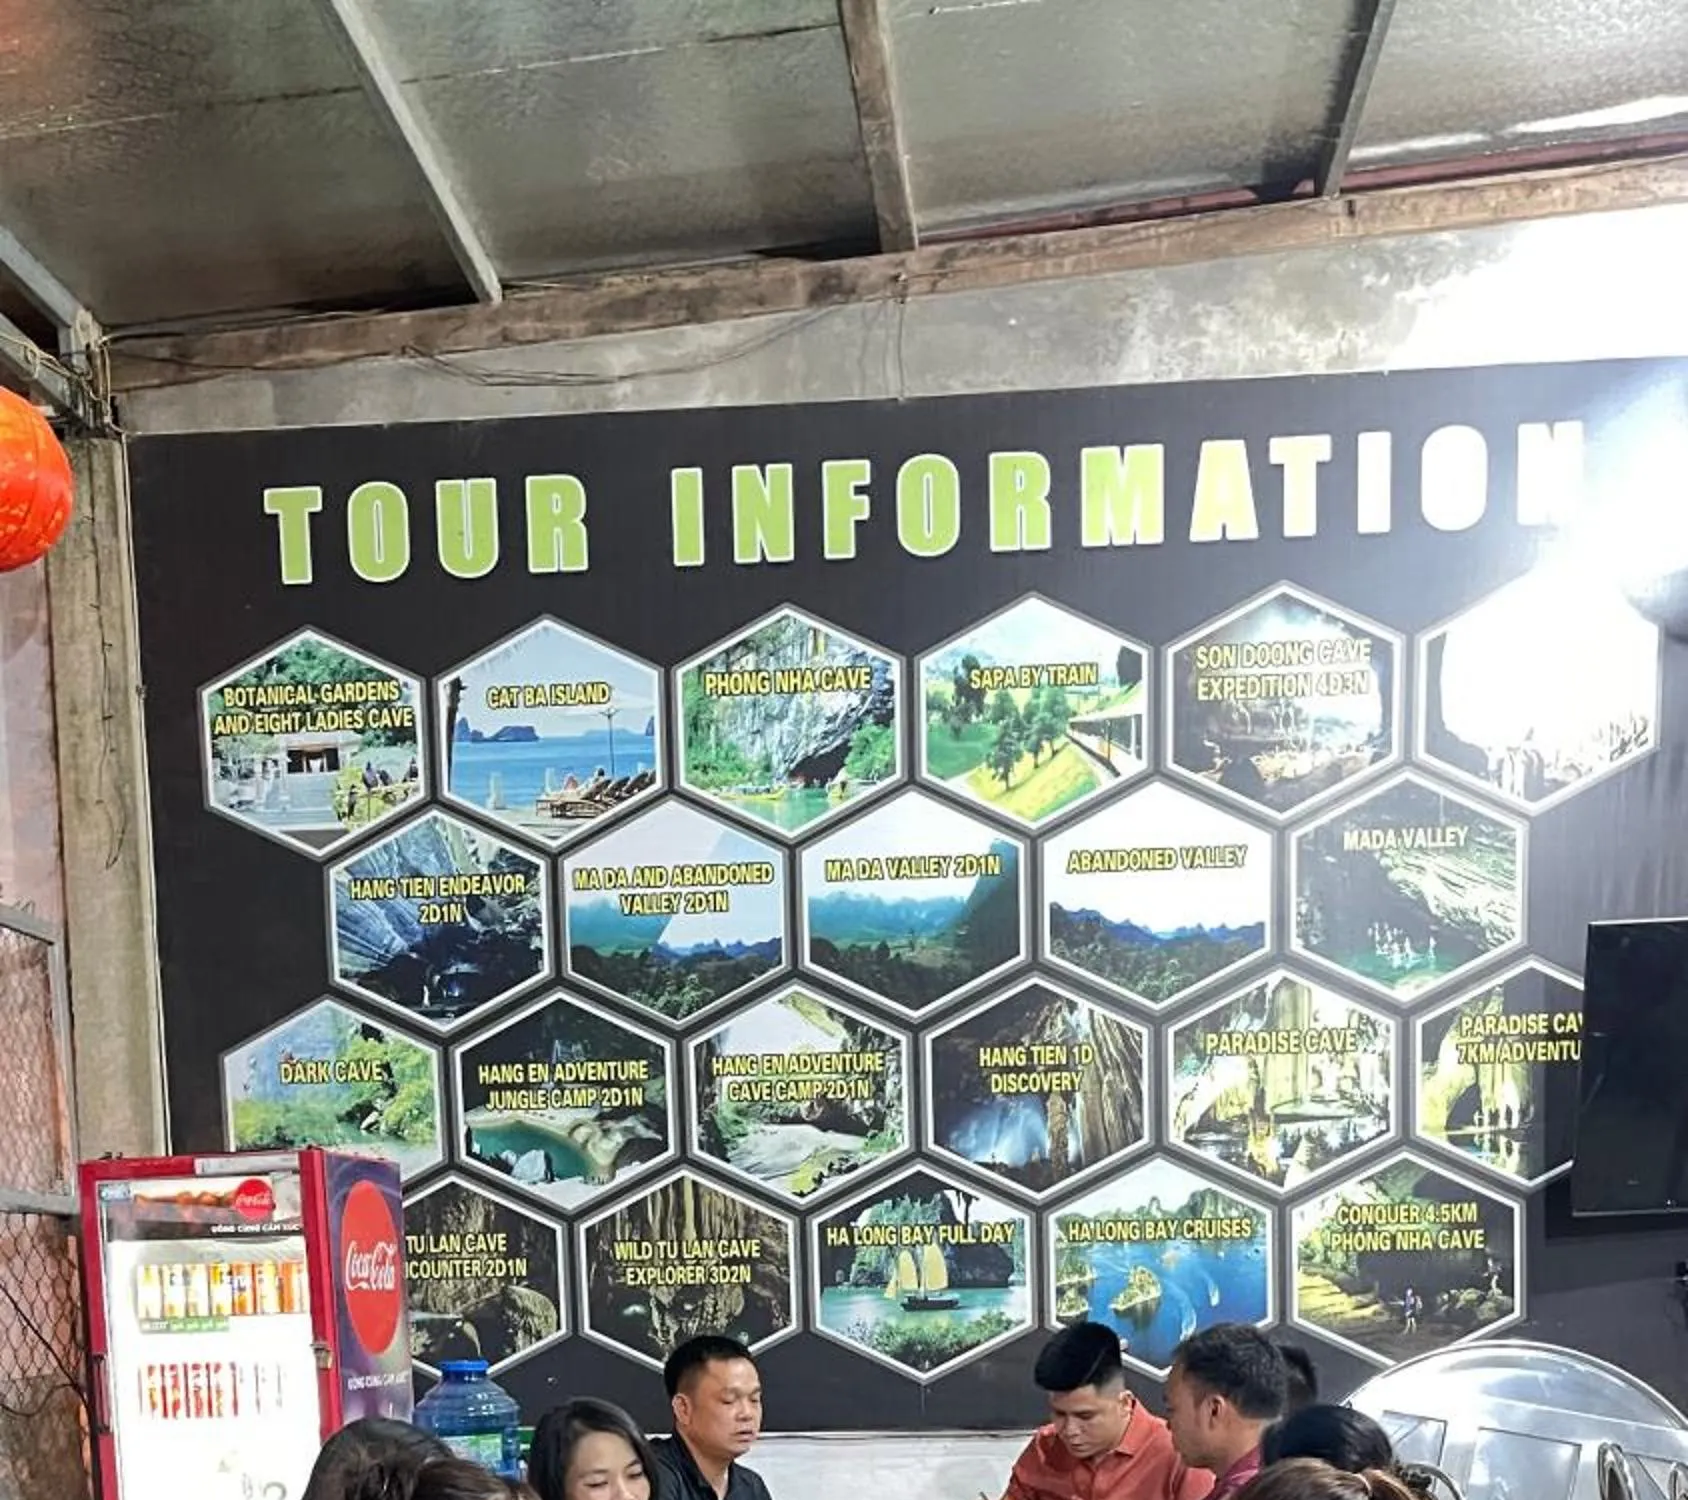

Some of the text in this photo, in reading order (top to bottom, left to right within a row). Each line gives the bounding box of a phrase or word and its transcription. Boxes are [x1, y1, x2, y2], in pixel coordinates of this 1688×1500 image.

[264, 420, 1584, 584] TOUR INFORMATION
[1196, 639, 1371, 669] SON DOONG CAVE
[705, 667, 871, 695] PHONG NHA CAVE
[969, 663, 1097, 689] SAPA BY TRAIN
[1198, 670, 1369, 701] EXPEDITION 4D3N
[223, 680, 400, 707] BOTANICAL GARDENS
[487, 682, 610, 707] CAT BA ISLAND
[214, 707, 413, 735] AND EIGHT LADIES CAVE
[1402, 825, 1469, 848] VALLEY
[825, 854, 1001, 882] MA DA VALLEY 2D1N
[1067, 845, 1247, 873] ABANDONED VALLEY
[350, 873, 526, 899] HANG TIEN ENDEAVOR
[574, 863, 774, 890] MA DA AND ABANDONED
[419, 902, 463, 924] 2D1N
[620, 890, 729, 915] VALLEY 2D1N
[1461, 1012, 1583, 1037] PARADISE CA
[1204, 1028, 1357, 1055] PARADISE CAVE
[1458, 1039, 1582, 1064] 7KM ADVENTU
[712, 1051, 884, 1077] HANG EN ADVENTURE
[979, 1044, 1094, 1068] HANG TIEN 1D
[279, 1058, 385, 1084] DARK CAVE
[478, 1059, 649, 1085] HANG EN ADVENTURE
[990, 1069, 1083, 1093] DISCOVERY
[486, 1086, 645, 1112] JUNGLE CAMP 2D1N
[728, 1077, 870, 1101] CAVE CAMP 2D1N
[1337, 1203, 1422, 1227] CONQUER
[826, 1223, 1016, 1246] HA LONG BAY FULL DAY
[1069, 1218, 1253, 1242] HA LONG BAY CRUISES
[1331, 1228, 1486, 1251] PHONG NHA CAVE
[405, 1232, 508, 1254] TU LAN CAVE
[613, 1238, 761, 1261] WILD TU LAN CAVE
[405, 1257, 528, 1279] COUNTER 2D1N
[625, 1264, 752, 1286] EXPLORER 3D2N
